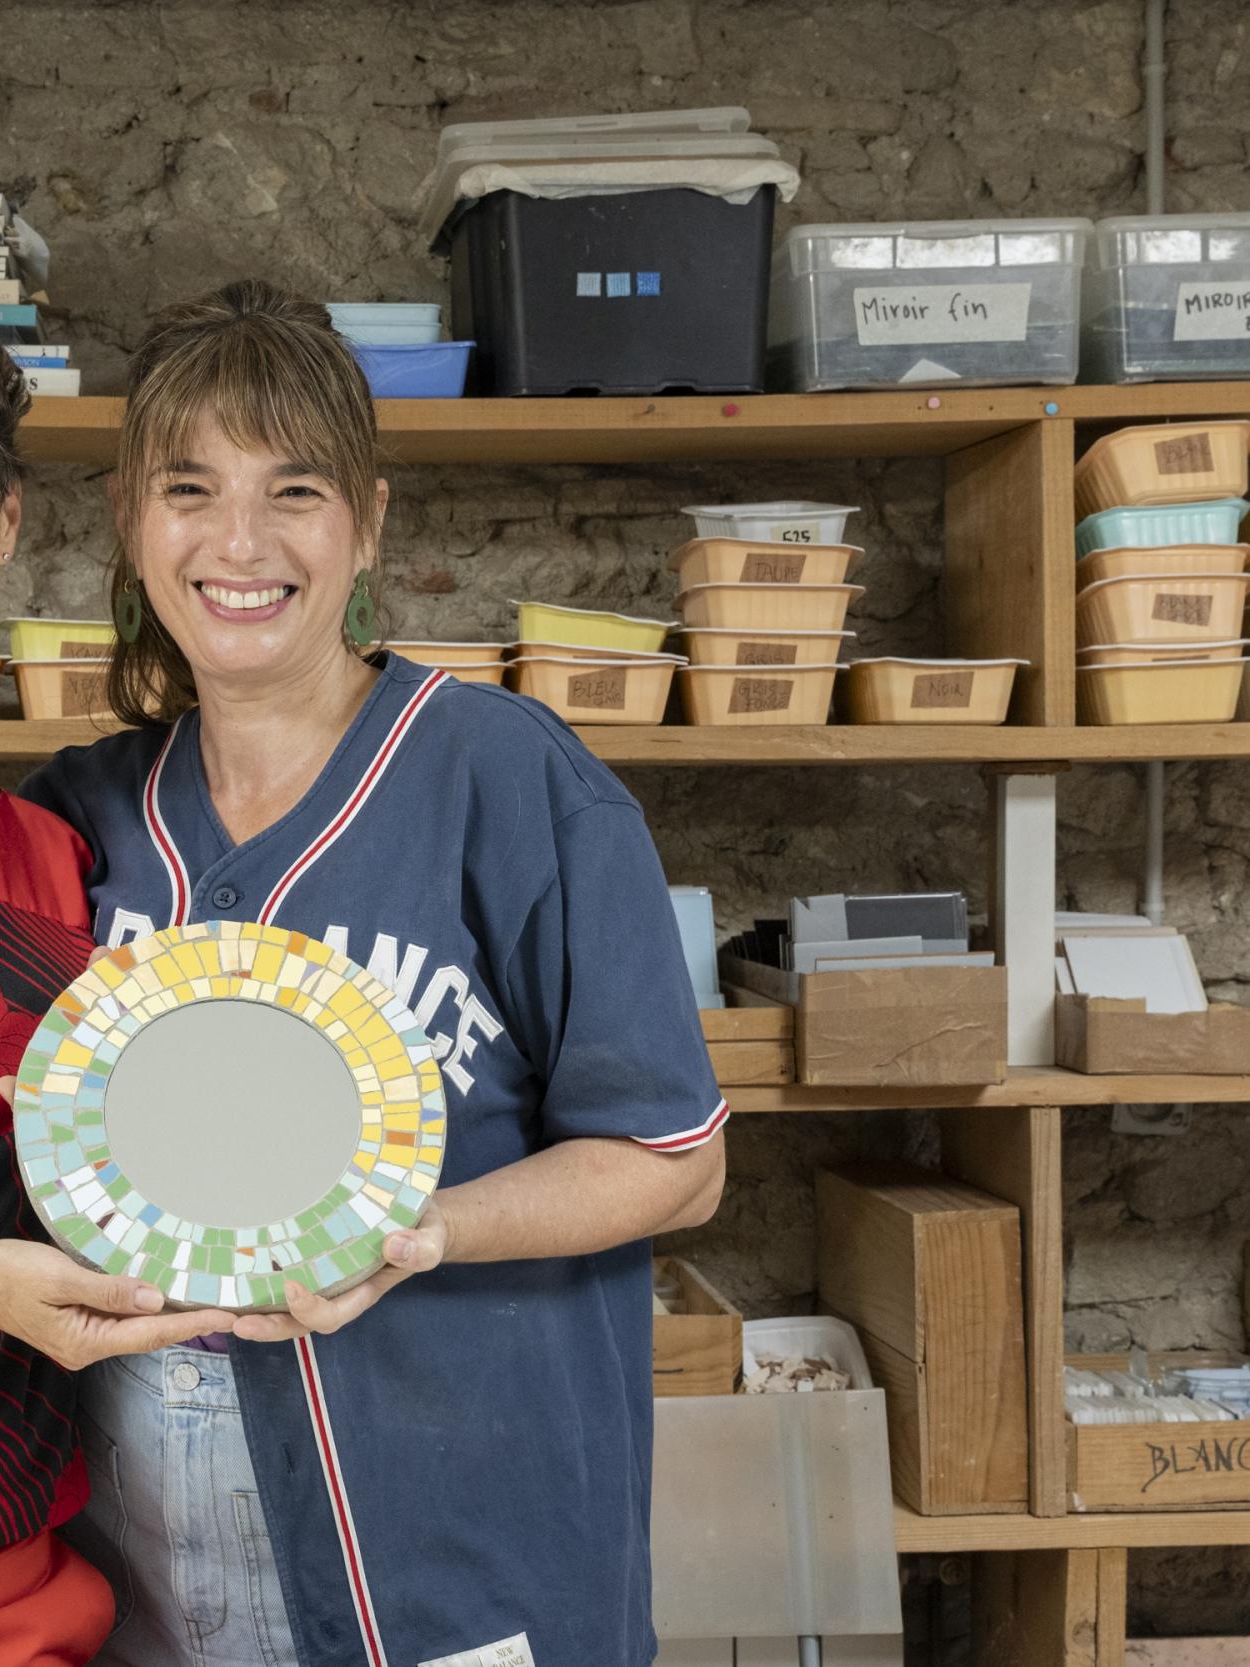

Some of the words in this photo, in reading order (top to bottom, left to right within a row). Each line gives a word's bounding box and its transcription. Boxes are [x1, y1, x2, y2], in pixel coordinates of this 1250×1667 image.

[861, 296, 930, 325] Miroir
[947, 292, 988, 322] fin
[572, 680, 616, 698] BLEU
